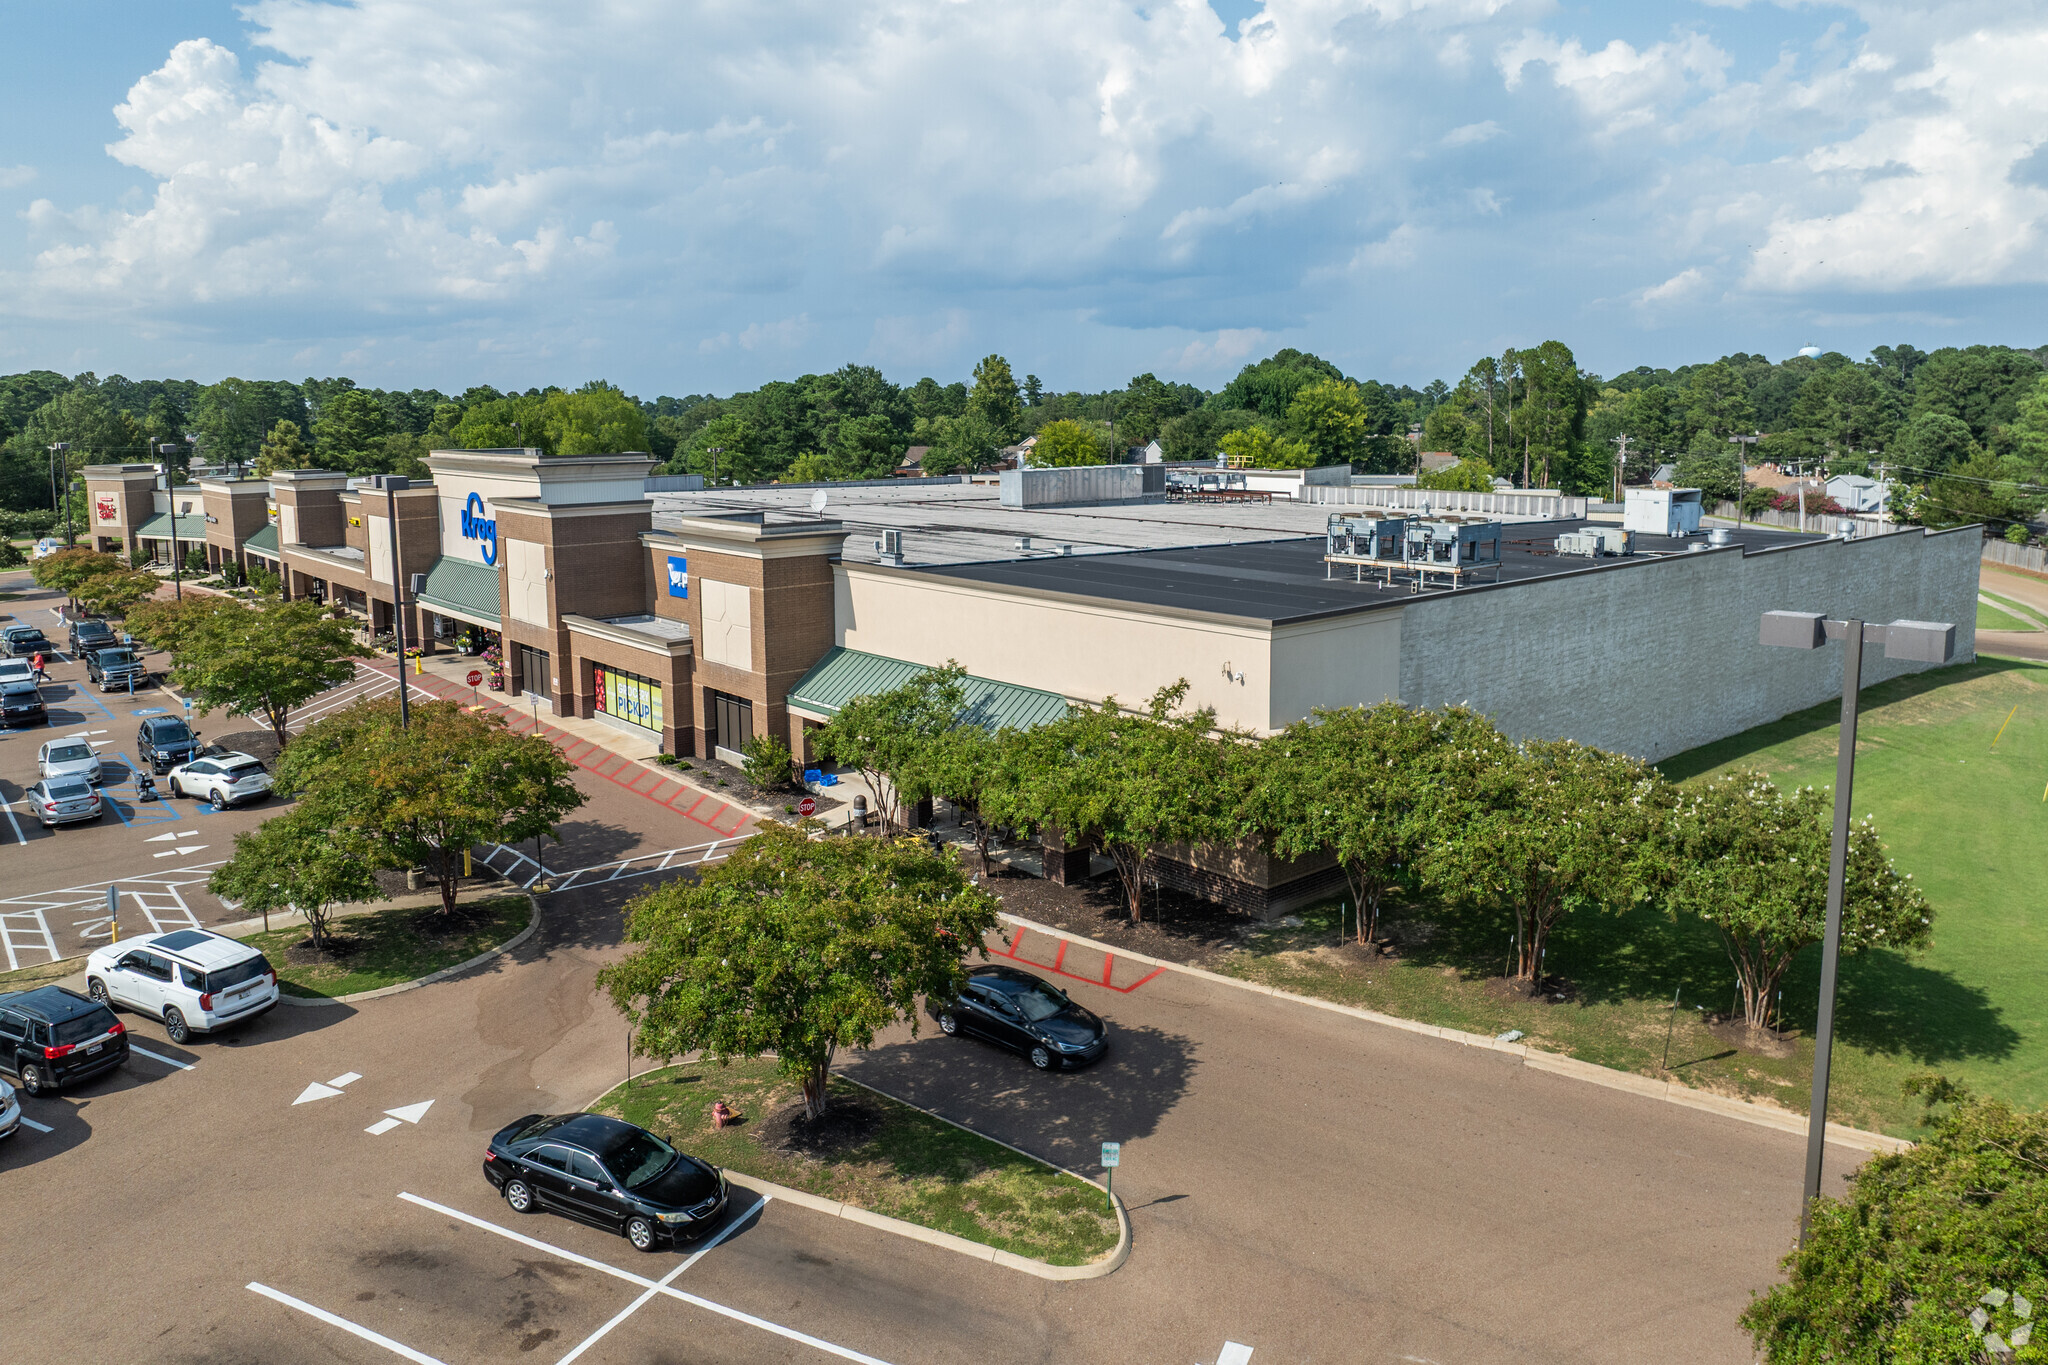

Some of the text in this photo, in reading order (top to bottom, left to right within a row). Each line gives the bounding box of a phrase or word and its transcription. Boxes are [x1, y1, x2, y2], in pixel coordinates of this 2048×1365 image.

[467, 674, 482, 683] STOP
[618, 683, 649, 702] GROCERY
[618, 696, 650, 719] PICKUP
[800, 803, 815, 812] STOP
